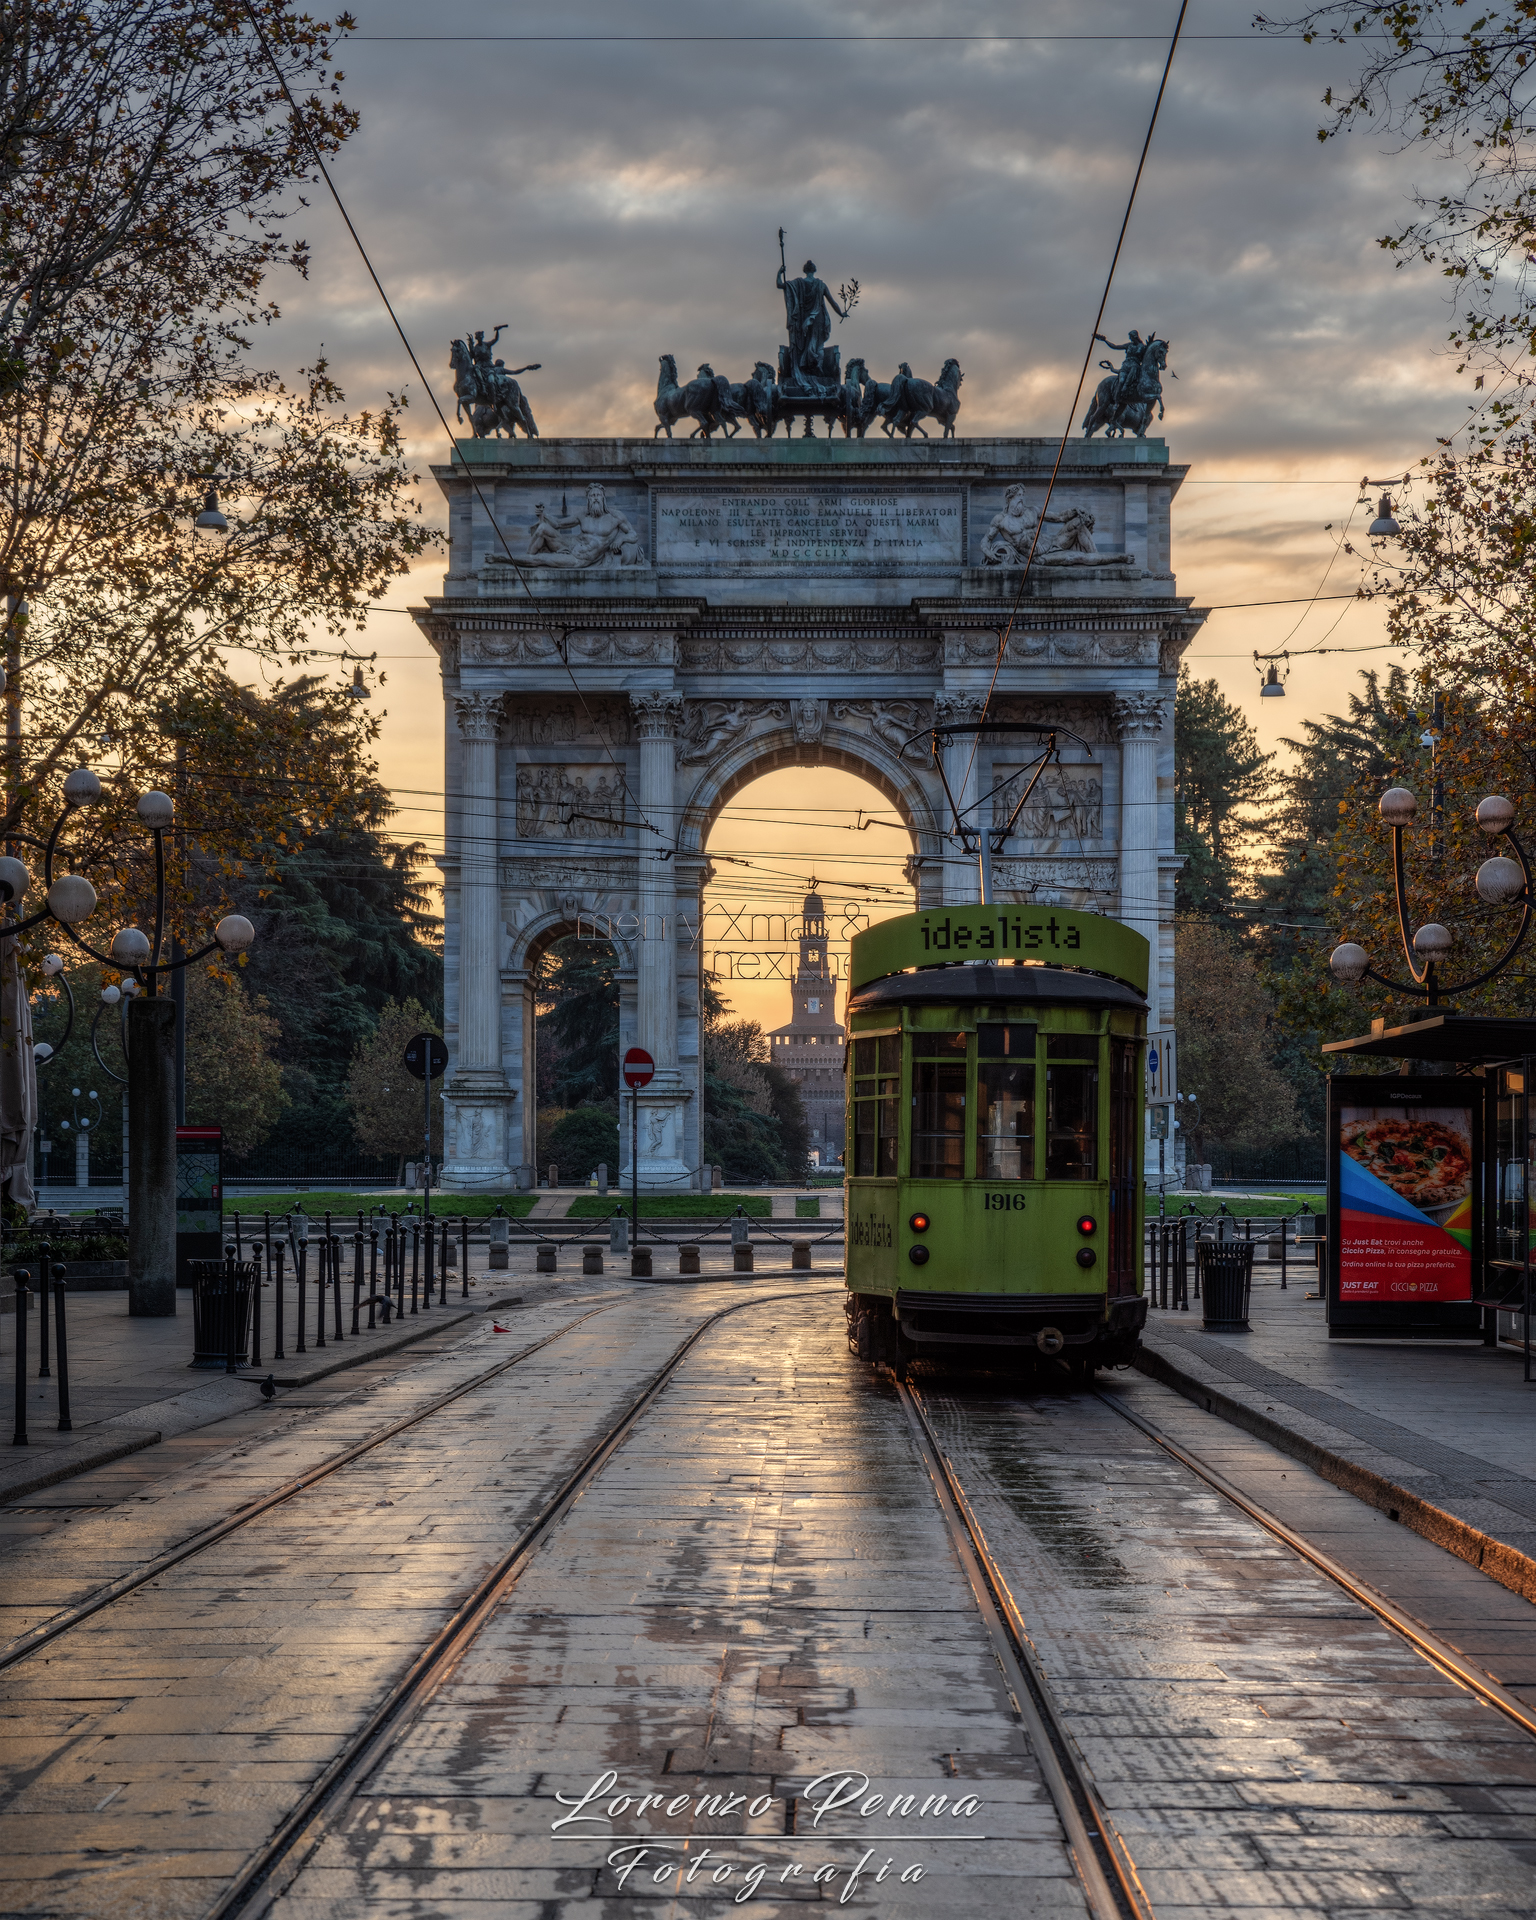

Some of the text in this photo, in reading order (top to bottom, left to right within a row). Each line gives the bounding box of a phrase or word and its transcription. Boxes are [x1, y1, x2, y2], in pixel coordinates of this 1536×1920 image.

[722, 498, 776, 507] ENTRANDO
[817, 498, 842, 507] ARMI
[850, 498, 898, 507] GLORIOSE
[661, 508, 957, 517] NAPOLEONE III E VITTORIO EMANUELE II LIBERATORI
[679, 519, 719, 527] MILANO
[727, 519, 781, 527] ESULTANTE
[845, 519, 858, 527] DA
[865, 519, 900, 528] QUESTI
[906, 519, 940, 527] MARMI
[751, 529, 868, 537] LE IMPRONTE SERVILI
[695, 539, 700, 547] E
[709, 539, 719, 547] VI
[727, 539, 766, 547] SCRISSE
[787, 539, 865, 547] INDIPENDENZA
[889, 539, 924, 547] ITALIA
[920, 916, 1081, 950] idealista
[984, 1192, 1026, 1211] 1916
[851, 1213, 892, 1248] idealista
[1365, 1247, 1387, 1255] Pizza,
[1431, 1248, 1462, 1256] gratuita.
[1407, 1261, 1424, 1269] pizza
[1425, 1261, 1456, 1269] preferita.
[1341, 1281, 1379, 1290] JUST EAT
[1419, 1282, 1439, 1292] PIZZA
